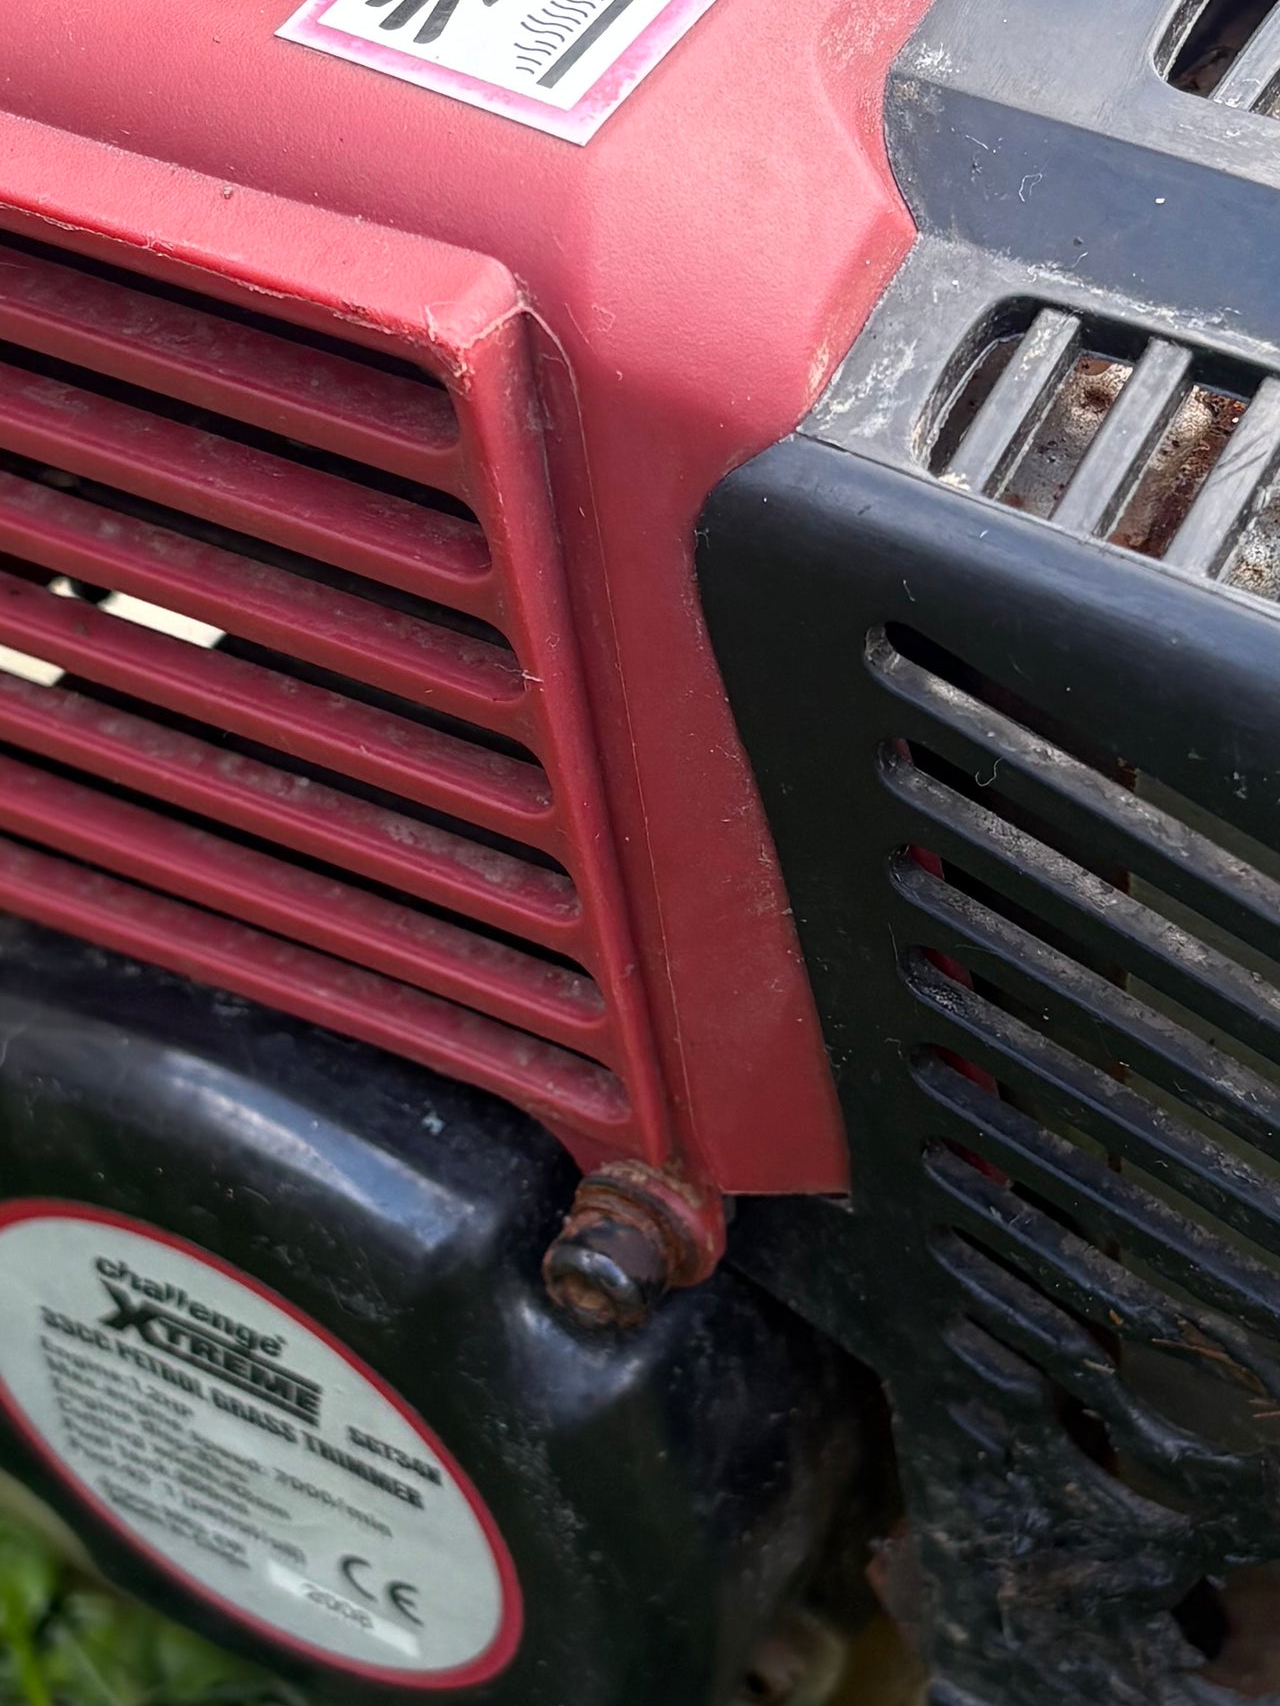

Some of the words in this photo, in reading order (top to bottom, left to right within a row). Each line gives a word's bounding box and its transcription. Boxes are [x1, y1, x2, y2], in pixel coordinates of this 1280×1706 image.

[94, 1255, 283, 1358] challenge
[97, 1277, 323, 1420] XTREME
[115, 1338, 208, 1401] PETROL
[209, 1386, 298, 1444] GRASS
[300, 1428, 425, 1511] TRIMMER
